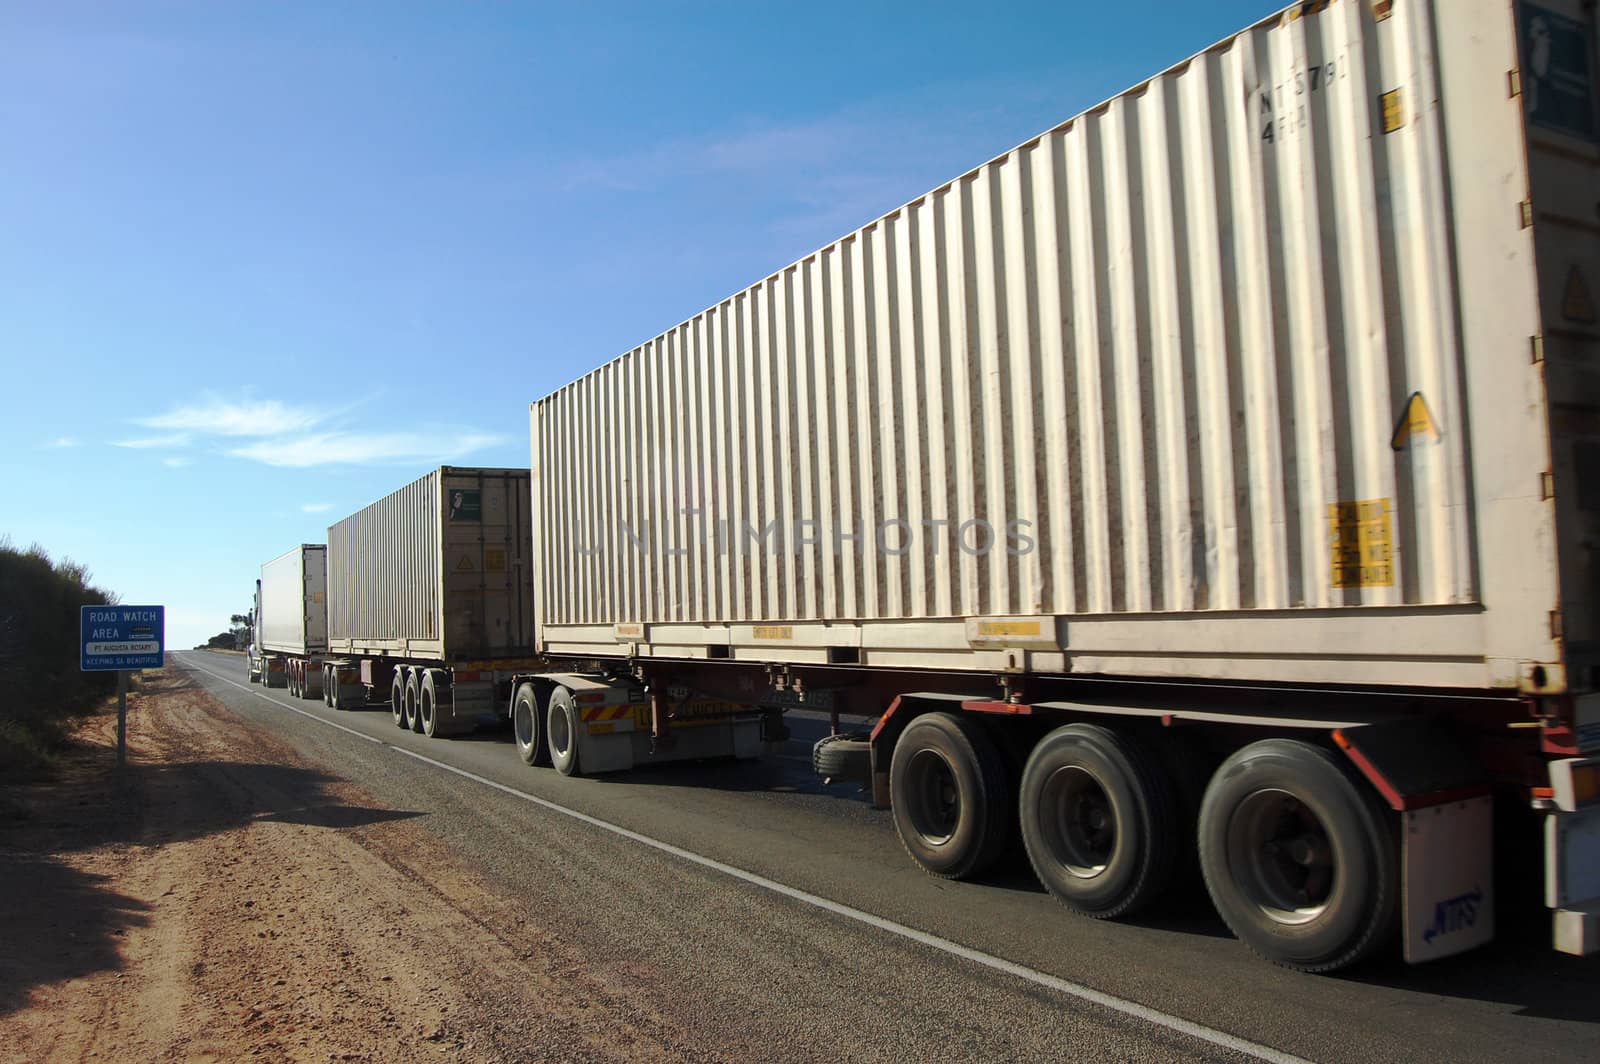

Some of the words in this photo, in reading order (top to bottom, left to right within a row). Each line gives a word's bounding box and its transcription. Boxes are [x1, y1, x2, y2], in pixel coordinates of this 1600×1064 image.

[89, 612, 117, 622] ROAD
[123, 610, 157, 622] WATCH
[92, 628, 120, 639] AREA
[86, 657, 114, 665] KEEPING
[126, 656, 160, 665] BEAUTIFUL
